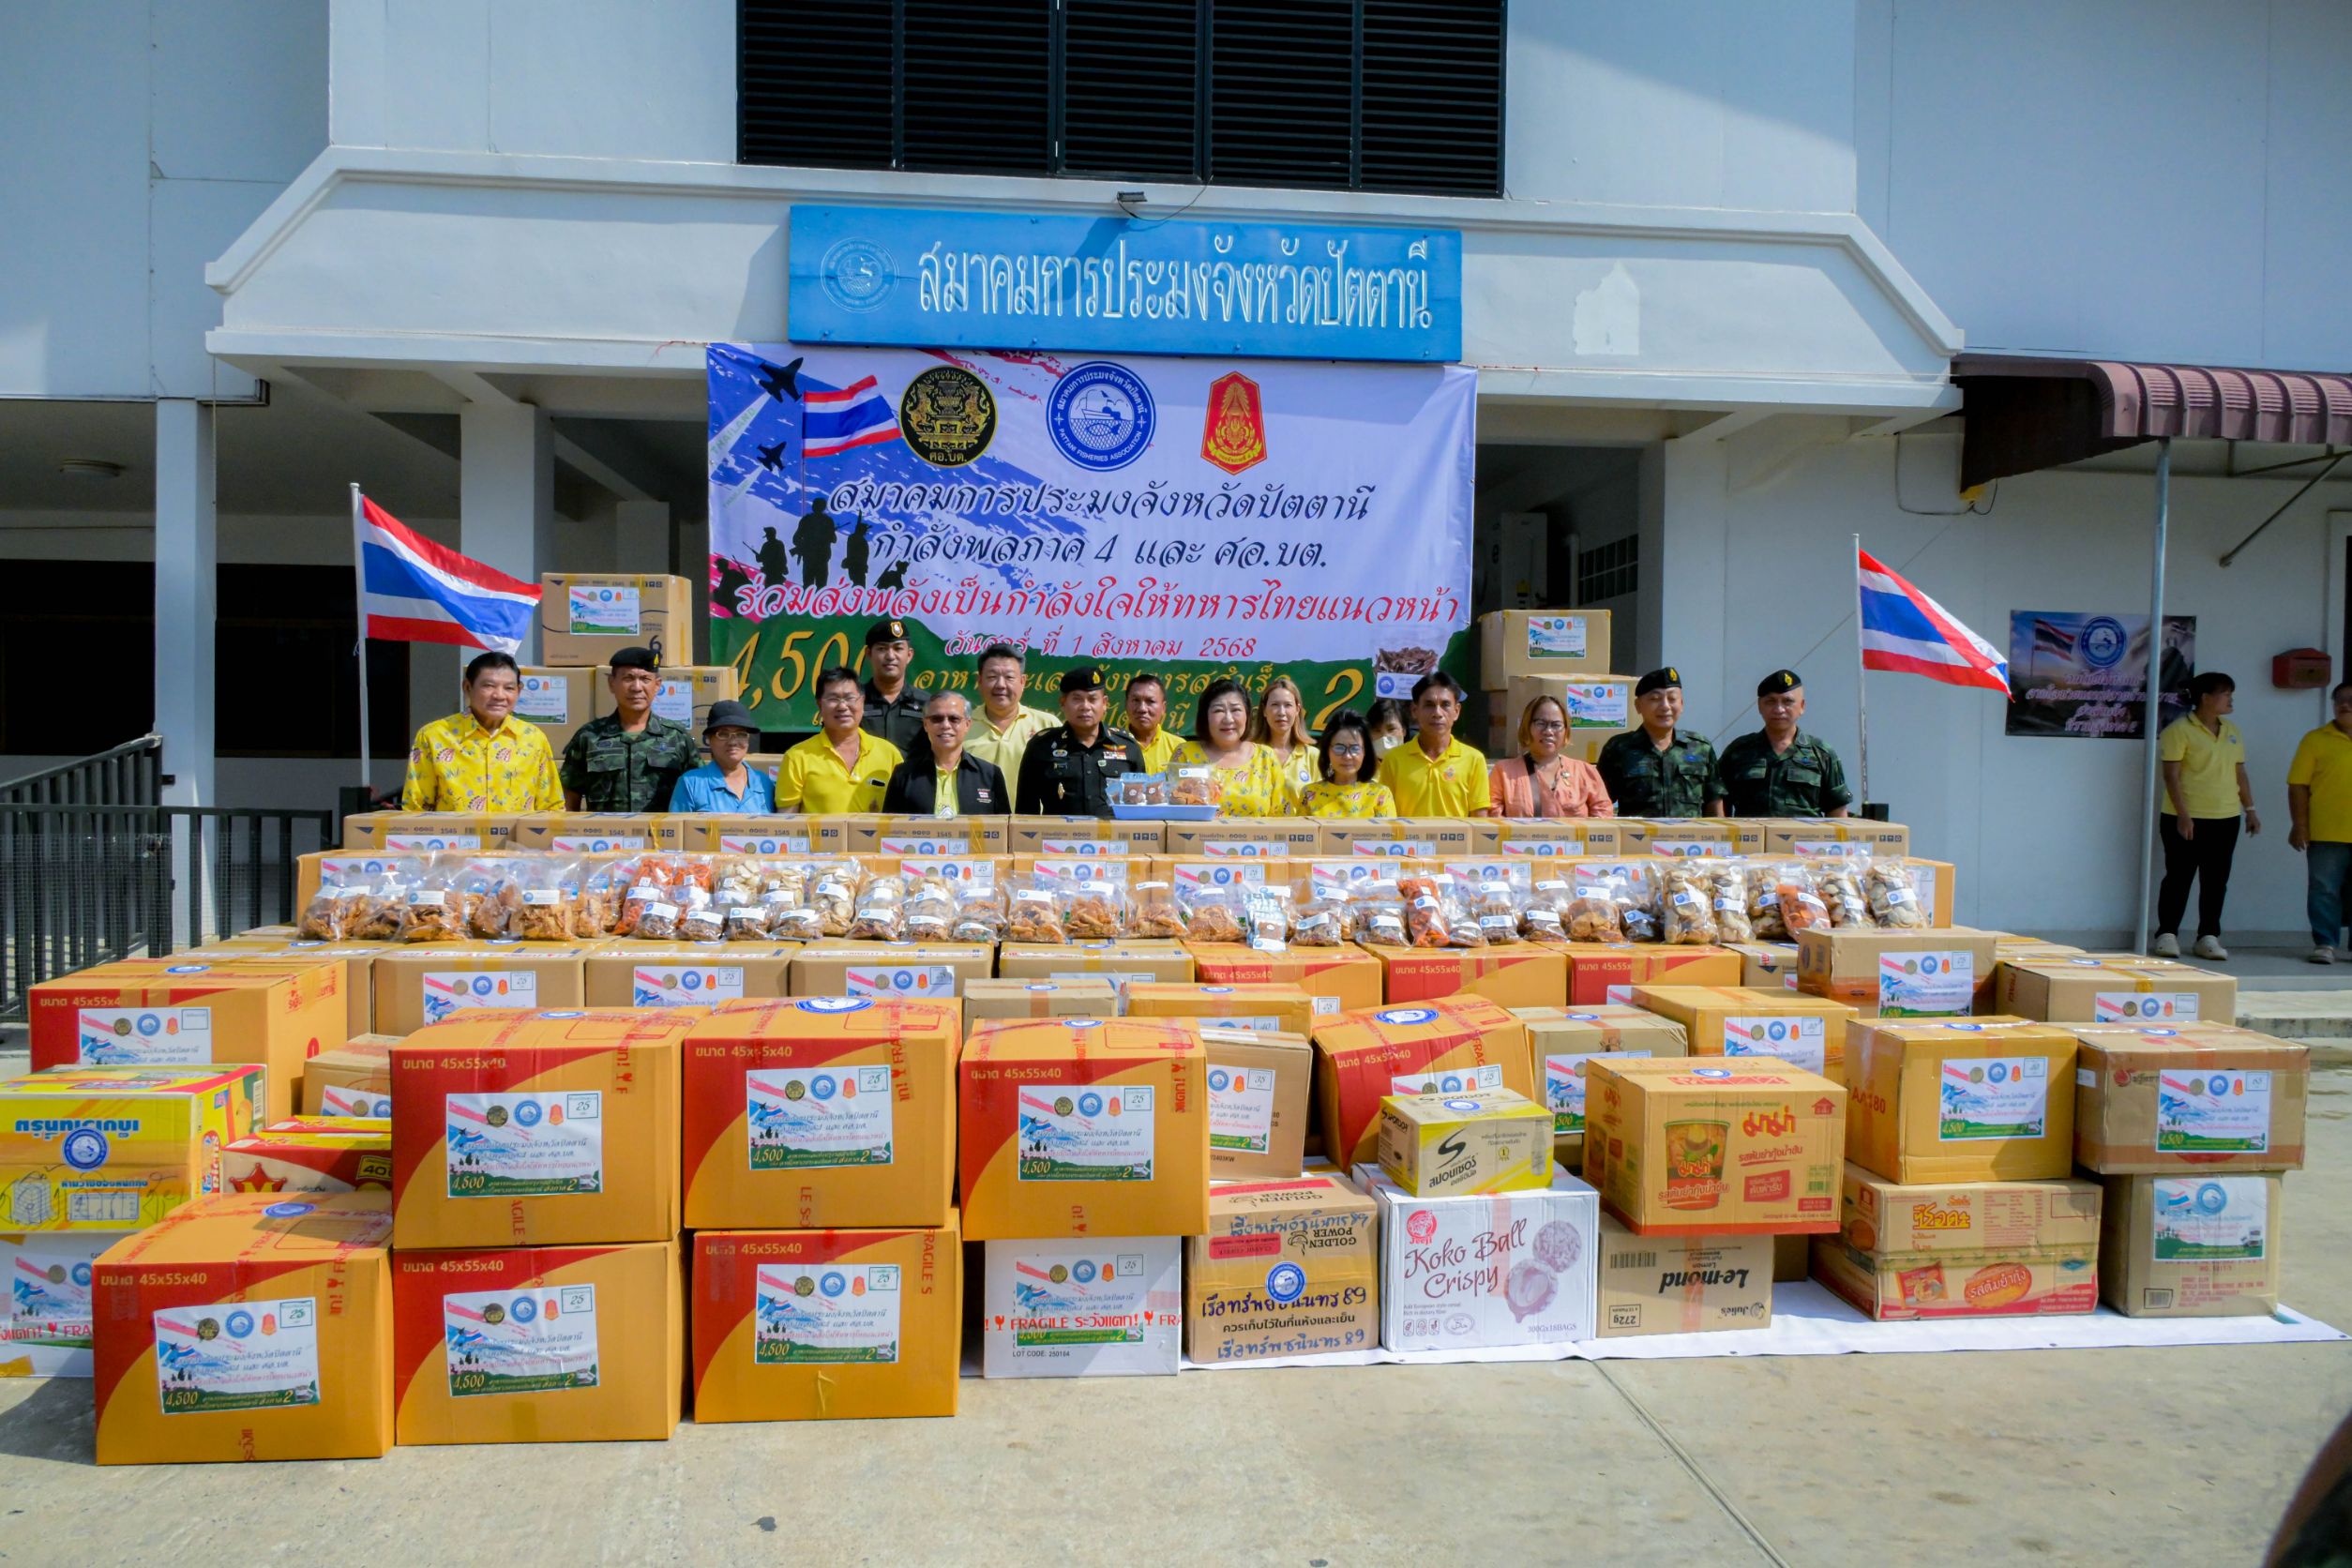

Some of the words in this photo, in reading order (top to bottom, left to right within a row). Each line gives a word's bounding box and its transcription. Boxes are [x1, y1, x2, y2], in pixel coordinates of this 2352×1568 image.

[918, 234, 1433, 328] สมาคมการประมงจังหวัดปัตตานี
[1059, 428, 1080, 452] PATTANI
[1076, 448, 1109, 462] FISHERIES
[1109, 430, 1142, 460] ASSOCIATION
[829, 478, 1376, 521] สมาคมการประมงจังหวัดปัตตานี
[874, 531, 1085, 565] กำลังพลภาค
[1094, 537, 1115, 565] 4
[1136, 537, 1205, 564] และ
[1215, 535, 1327, 568] ศอ.บต.
[733, 575, 1460, 626] ร่วมส่งพลังเป็นกำลังใจให้ทหารไทยแนวหน้า
[1040, 626, 1064, 656] ที่
[1073, 635, 1083, 655] 1
[1091, 632, 1183, 656] สิงหาคม
[1199, 637, 1257, 656] 2568
[729, 630, 869, 710] 4,50
[1311, 667, 1364, 731] 2
[1395, 964, 1416, 974] ขนาด
[1419, 964, 1461, 974] 45x55x40
[1578, 962, 1600, 972] ขนาด
[1602, 961, 1632, 972] 45x55x
[39, 996, 68, 1007] ขนาด
[696, 1046, 726, 1057] ขนาด
[731, 1046, 792, 1058] 45x5x40
[402, 1059, 434, 1070] ขนาด
[1003, 1067, 1062, 1079] 45x55x40
[1336, 1057, 1361, 1069] ขนาด
[1742, 1105, 1797, 1138] มาม่า
[1428, 1153, 1478, 1189] สปอนเซอร์
[1678, 1154, 1712, 1178] มาม่า
[1259, 1193, 1323, 1202] GOLDEN
[510, 1199, 526, 1236] GILE
[1308, 1235, 1358, 1249] GOLDEN
[1312, 1227, 1353, 1238] POWER
[741, 1243, 803, 1255] 45x55x40
[921, 1227, 935, 1283] FRAGILE
[1403, 1238, 1467, 1279] Koko
[1471, 1217, 1529, 1262] Ball
[403, 1261, 434, 1274] ขนาด
[440, 1260, 504, 1273] 45x55x40
[139, 1273, 207, 1286] 45x55x40
[1424, 1264, 1500, 1300] Crispy
[1658, 1269, 1749, 1294] Le-mond
[1969, 1268, 2028, 1299] รสต้มยำกุ้ง
[1343, 1286, 1367, 1306] 89
[1010, 1316, 1070, 1330] FRAGILE
[1075, 1312, 1139, 1329] ระวังแตก!
[1613, 1315, 1636, 1325] 272g
[1720, 1305, 1749, 1318] Julie's
[1222, 1312, 1356, 1334] ควรเก็บไว้ในที่แห้งและเย็น
[1345, 1328, 1365, 1346] 89
